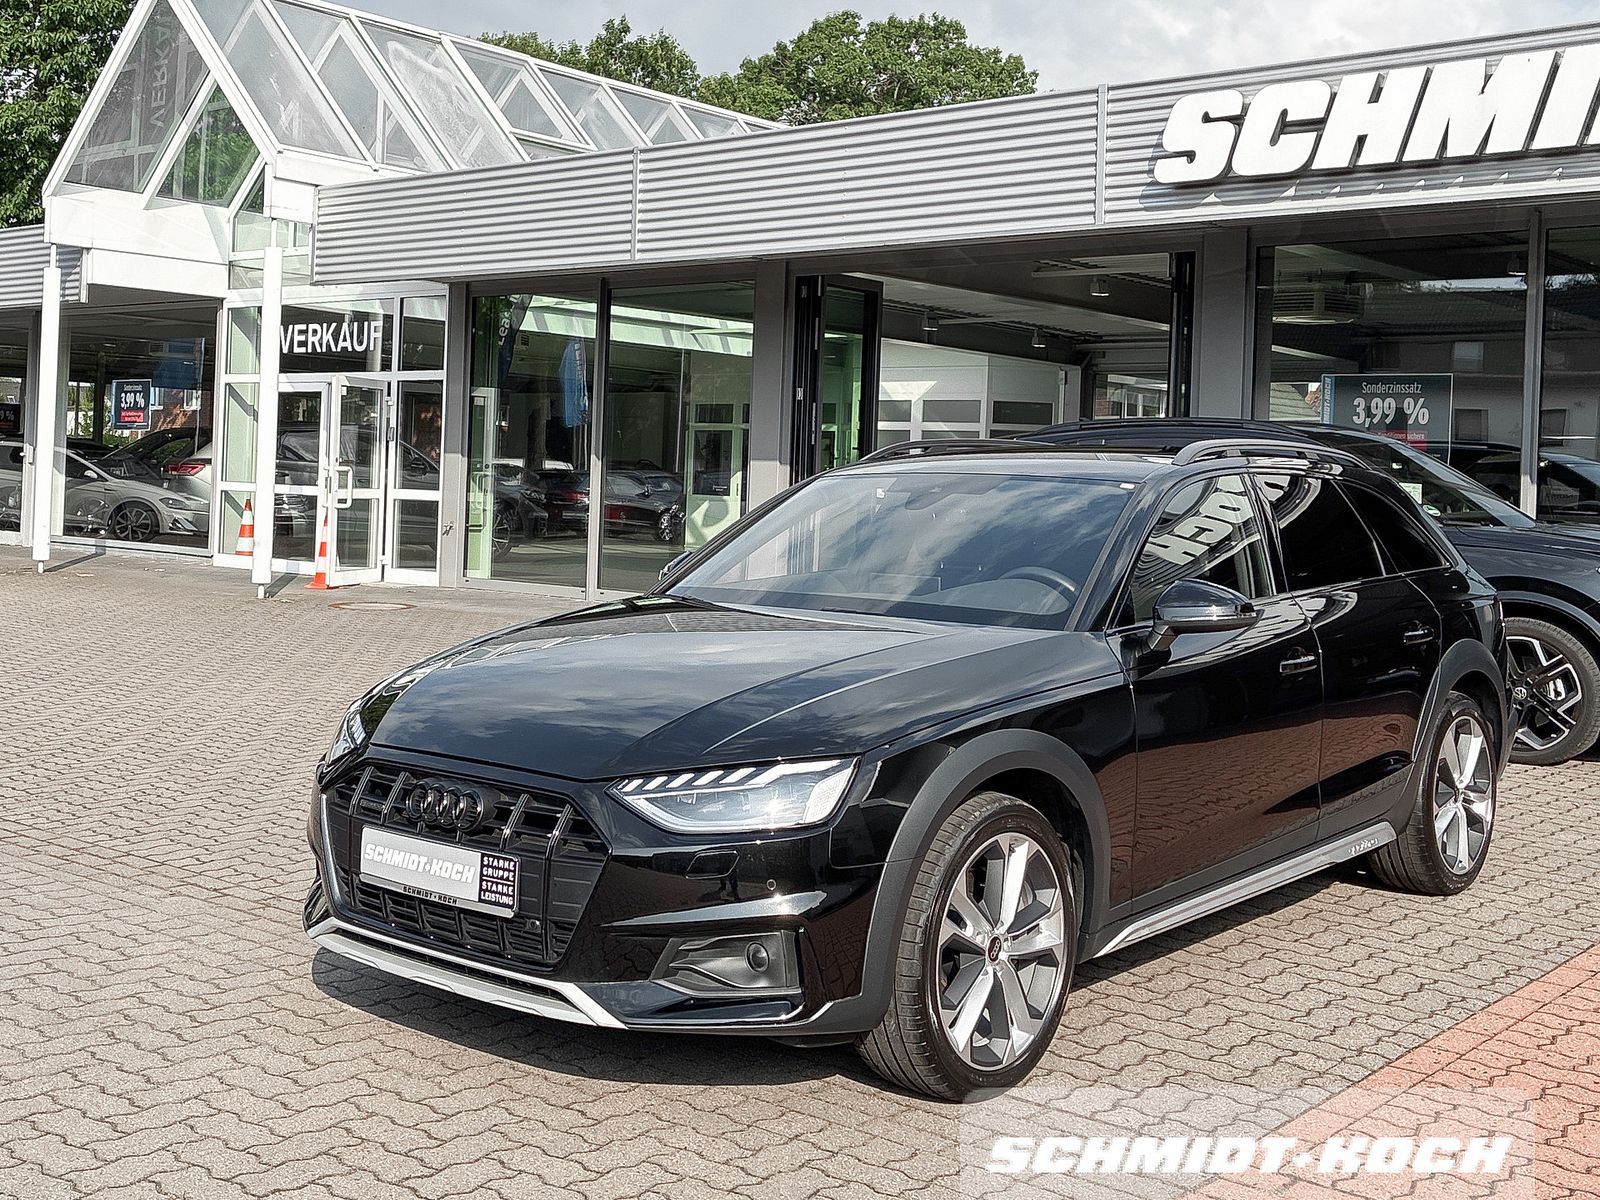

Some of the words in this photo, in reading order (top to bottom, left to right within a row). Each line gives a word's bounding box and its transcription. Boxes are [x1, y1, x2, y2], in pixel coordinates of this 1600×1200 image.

[1153, 43, 1600, 184] SCHMI
[279, 320, 383, 354] VERKAUF
[1362, 382, 1422, 394] Sonderzinssatz
[120, 392, 135, 410] 3,99
[136, 392, 145, 408] %
[1352, 397, 1396, 428] 3,99
[1403, 397, 1430, 425] %
[482, 856, 515, 871] STARKE
[482, 866, 515, 881] GRUPPE
[482, 880, 514, 895] STARKE
[480, 890, 514, 906] LEISTUNG
